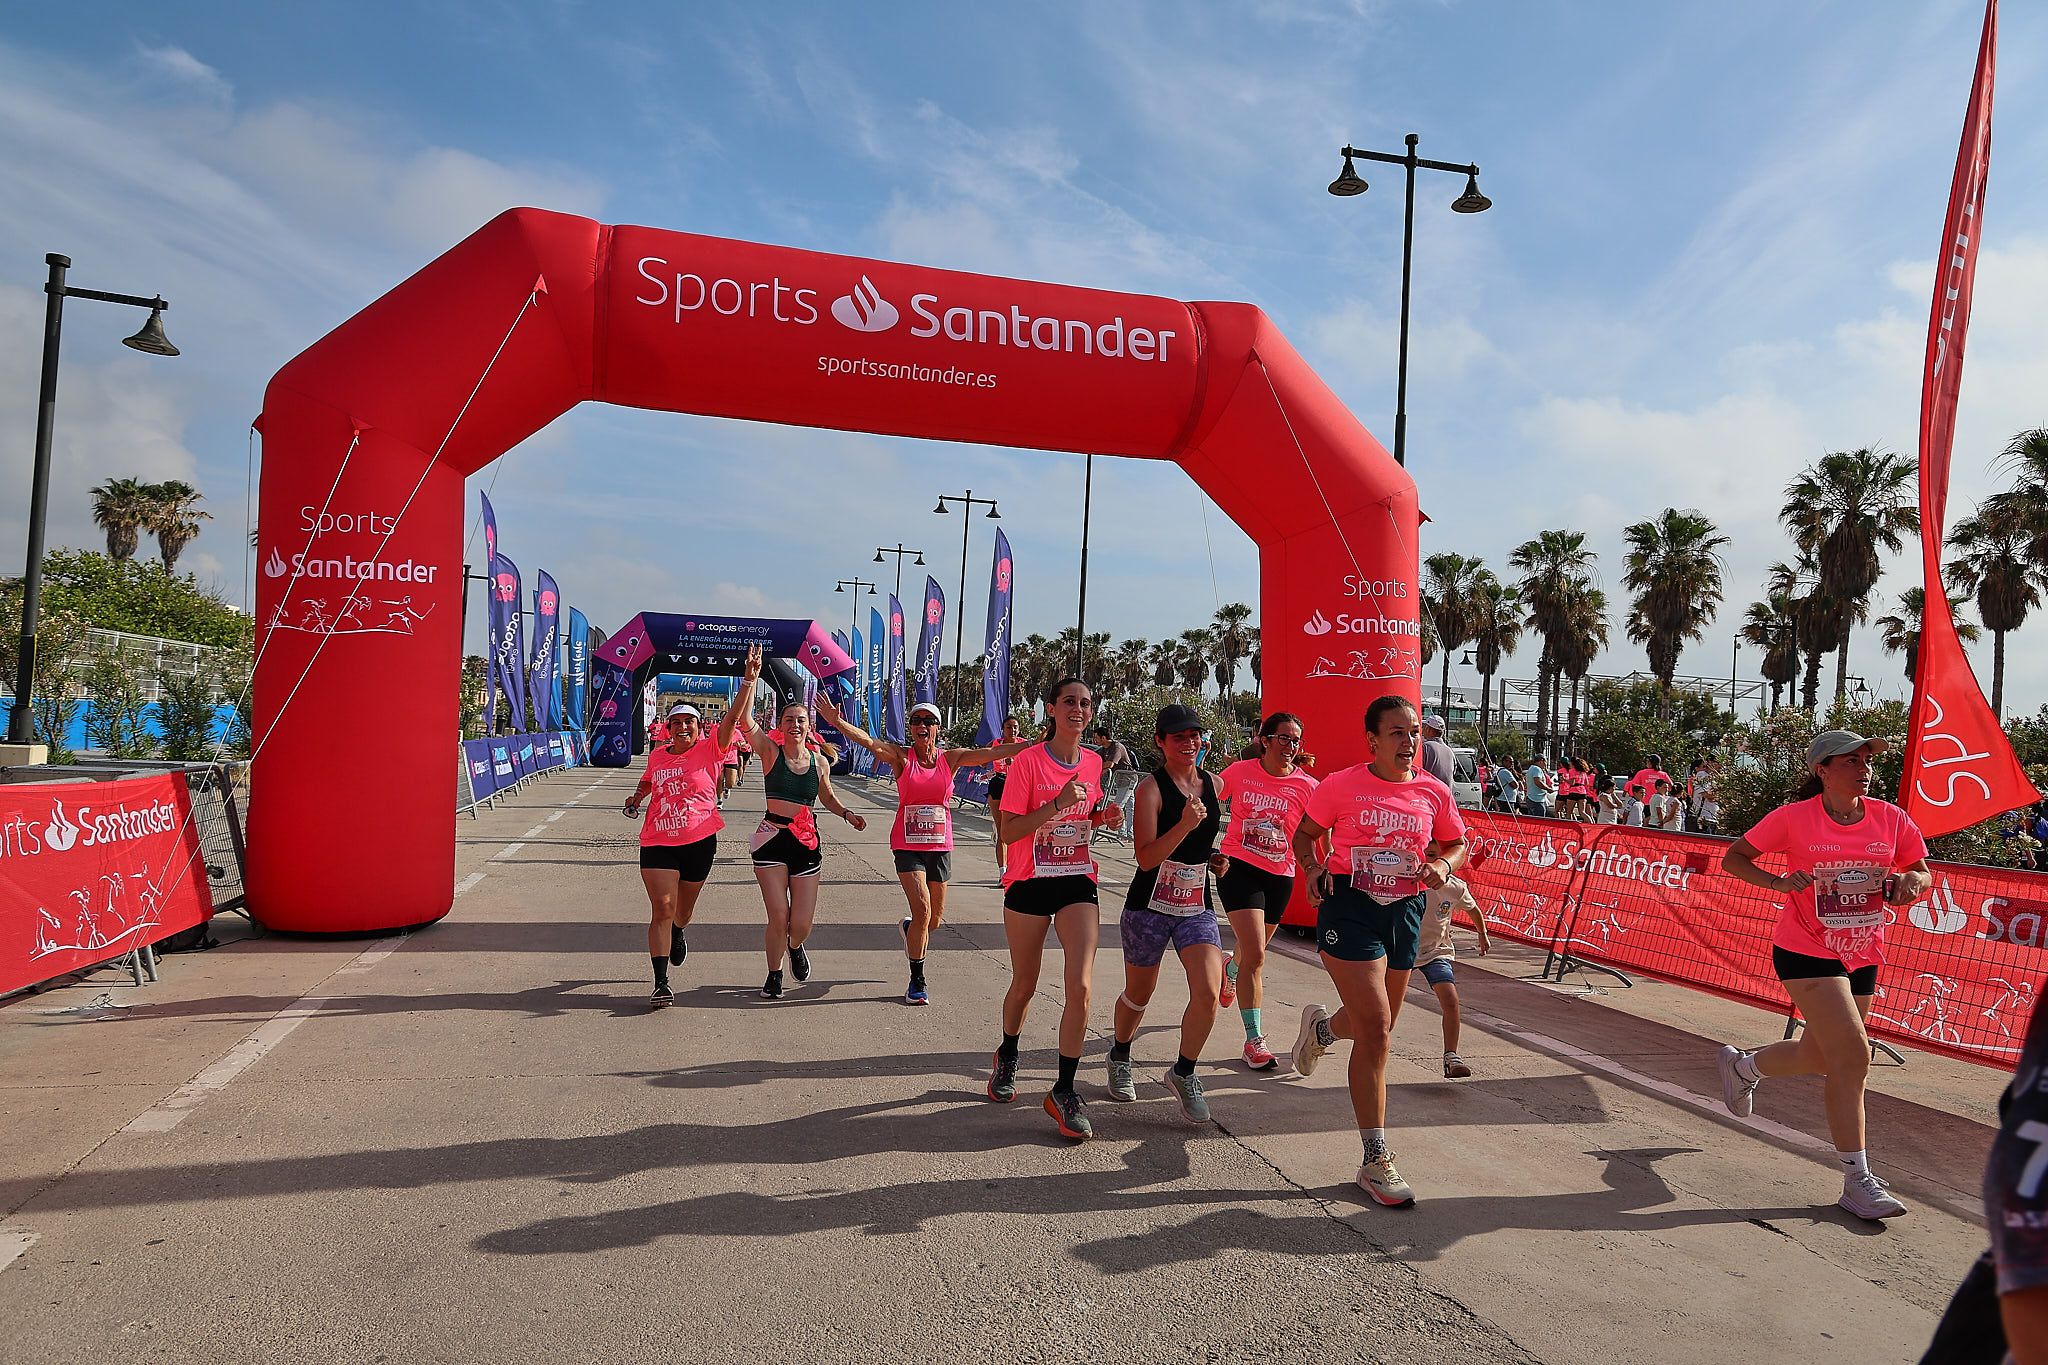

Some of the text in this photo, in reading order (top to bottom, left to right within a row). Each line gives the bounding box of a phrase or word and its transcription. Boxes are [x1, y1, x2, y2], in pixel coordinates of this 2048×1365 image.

[636, 256, 1176, 363] Sports Santander
[817, 355, 997, 389] sportssantander.es
[300, 505, 396, 539] Sports
[290, 553, 438, 584] Santander
[1343, 575, 1407, 602] Sports
[698, 623, 770, 636] octopus energy
[1336, 613, 1420, 638] Santande
[695, 642, 737, 650] VELOCIDAD
[668, 654, 748, 666] VOLV
[1036, 783, 1062, 791] OYSHO
[1242, 791, 1289, 812] CARRERA
[78, 799, 176, 846] Santander
[655, 815, 688, 832] MUJER
[917, 821, 935, 829] 016
[1360, 809, 1423, 835] CARRERA
[1258, 835, 1276, 846] 016
[1808, 844, 1841, 852] OYSHO
[1053, 846, 1075, 856] 016
[1557, 840, 1697, 891] Santander
[1374, 874, 1397, 886] 016
[1173, 887, 1193, 898] 016
[1840, 893, 1868, 905] 016
[1824, 935, 1873, 952] MUJER
